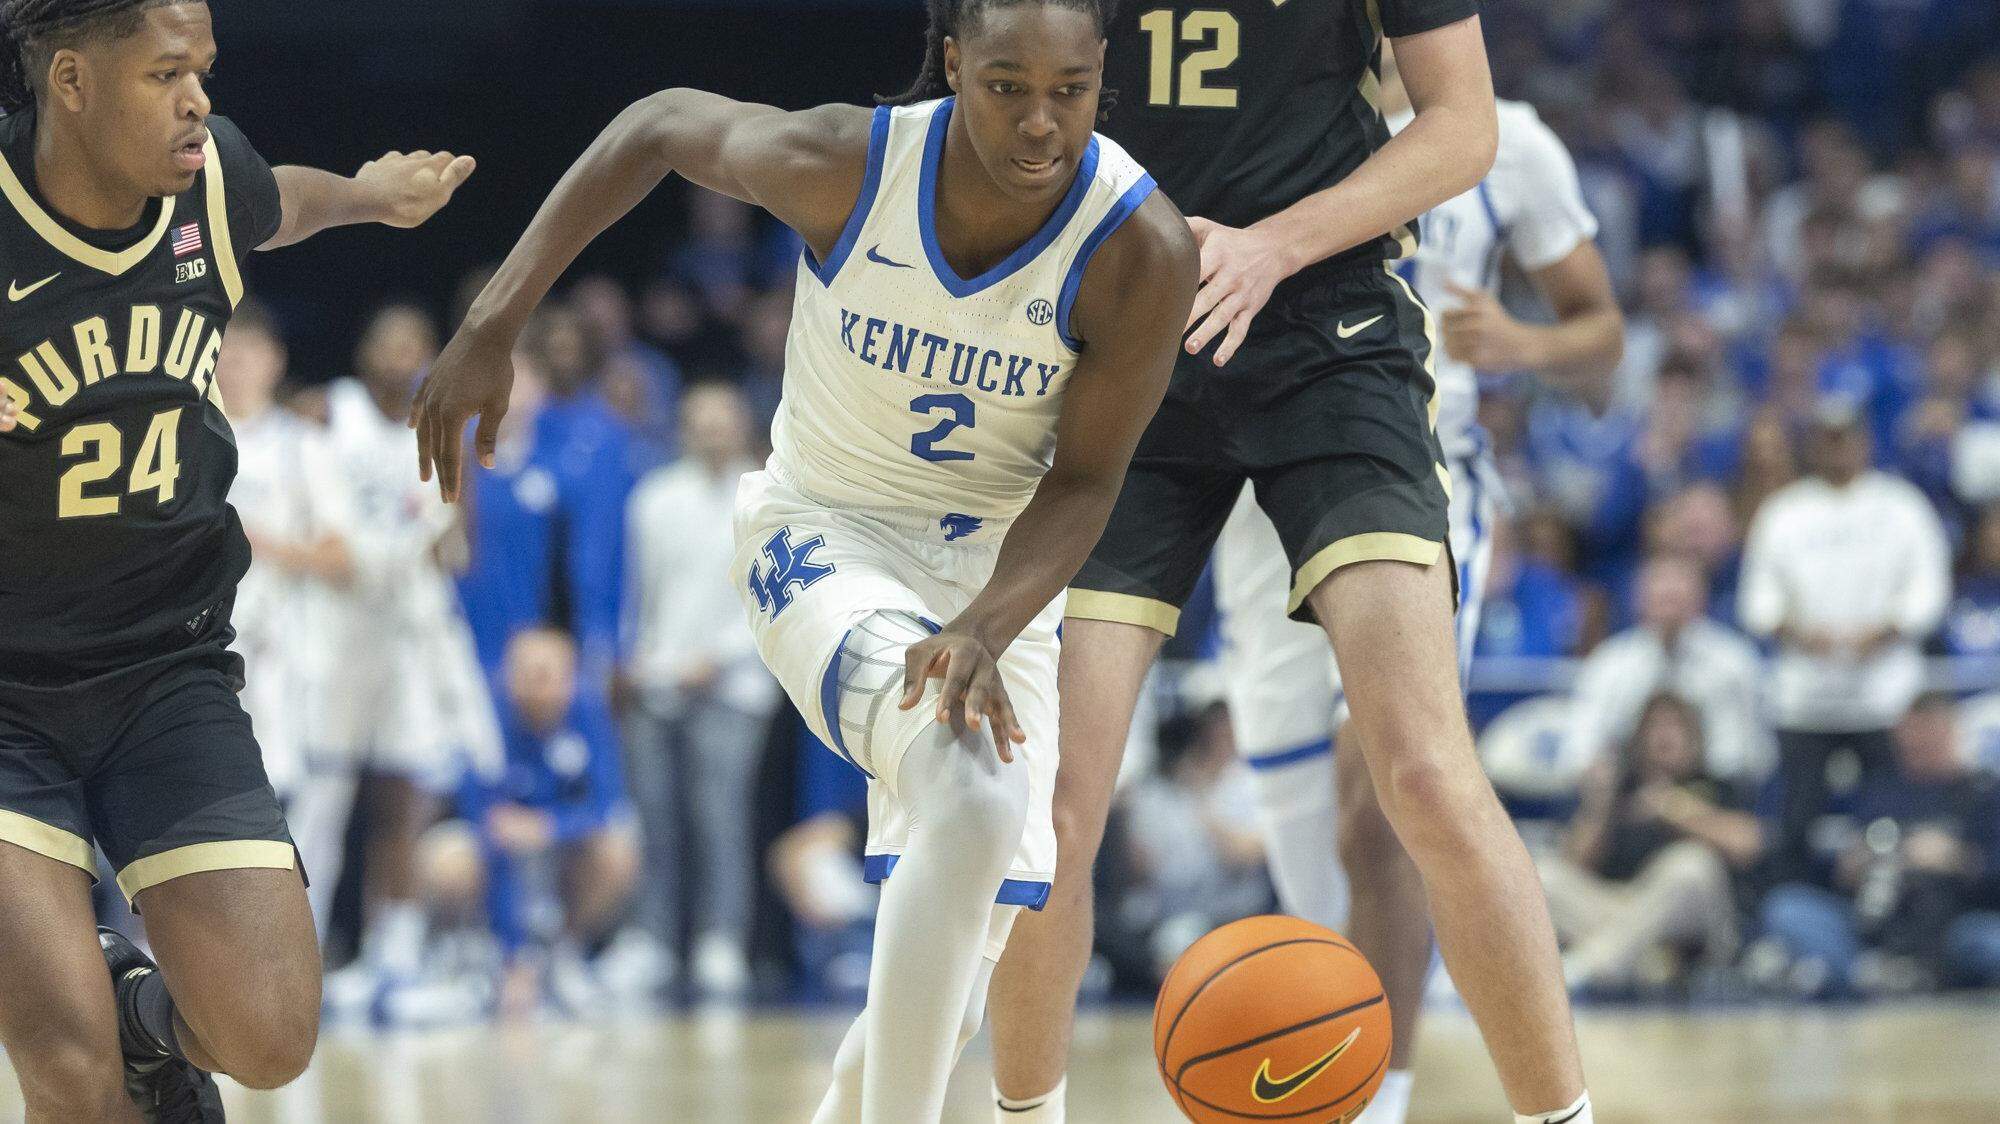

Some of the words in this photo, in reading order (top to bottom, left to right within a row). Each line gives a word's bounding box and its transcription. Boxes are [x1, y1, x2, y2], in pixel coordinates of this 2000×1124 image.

[1139, 9, 1240, 108] 12
[840, 308, 1060, 397] KENTUCKY
[1027, 299, 1053, 325] SEC
[58, 407, 183, 518] 24
[910, 393, 976, 461] 2
